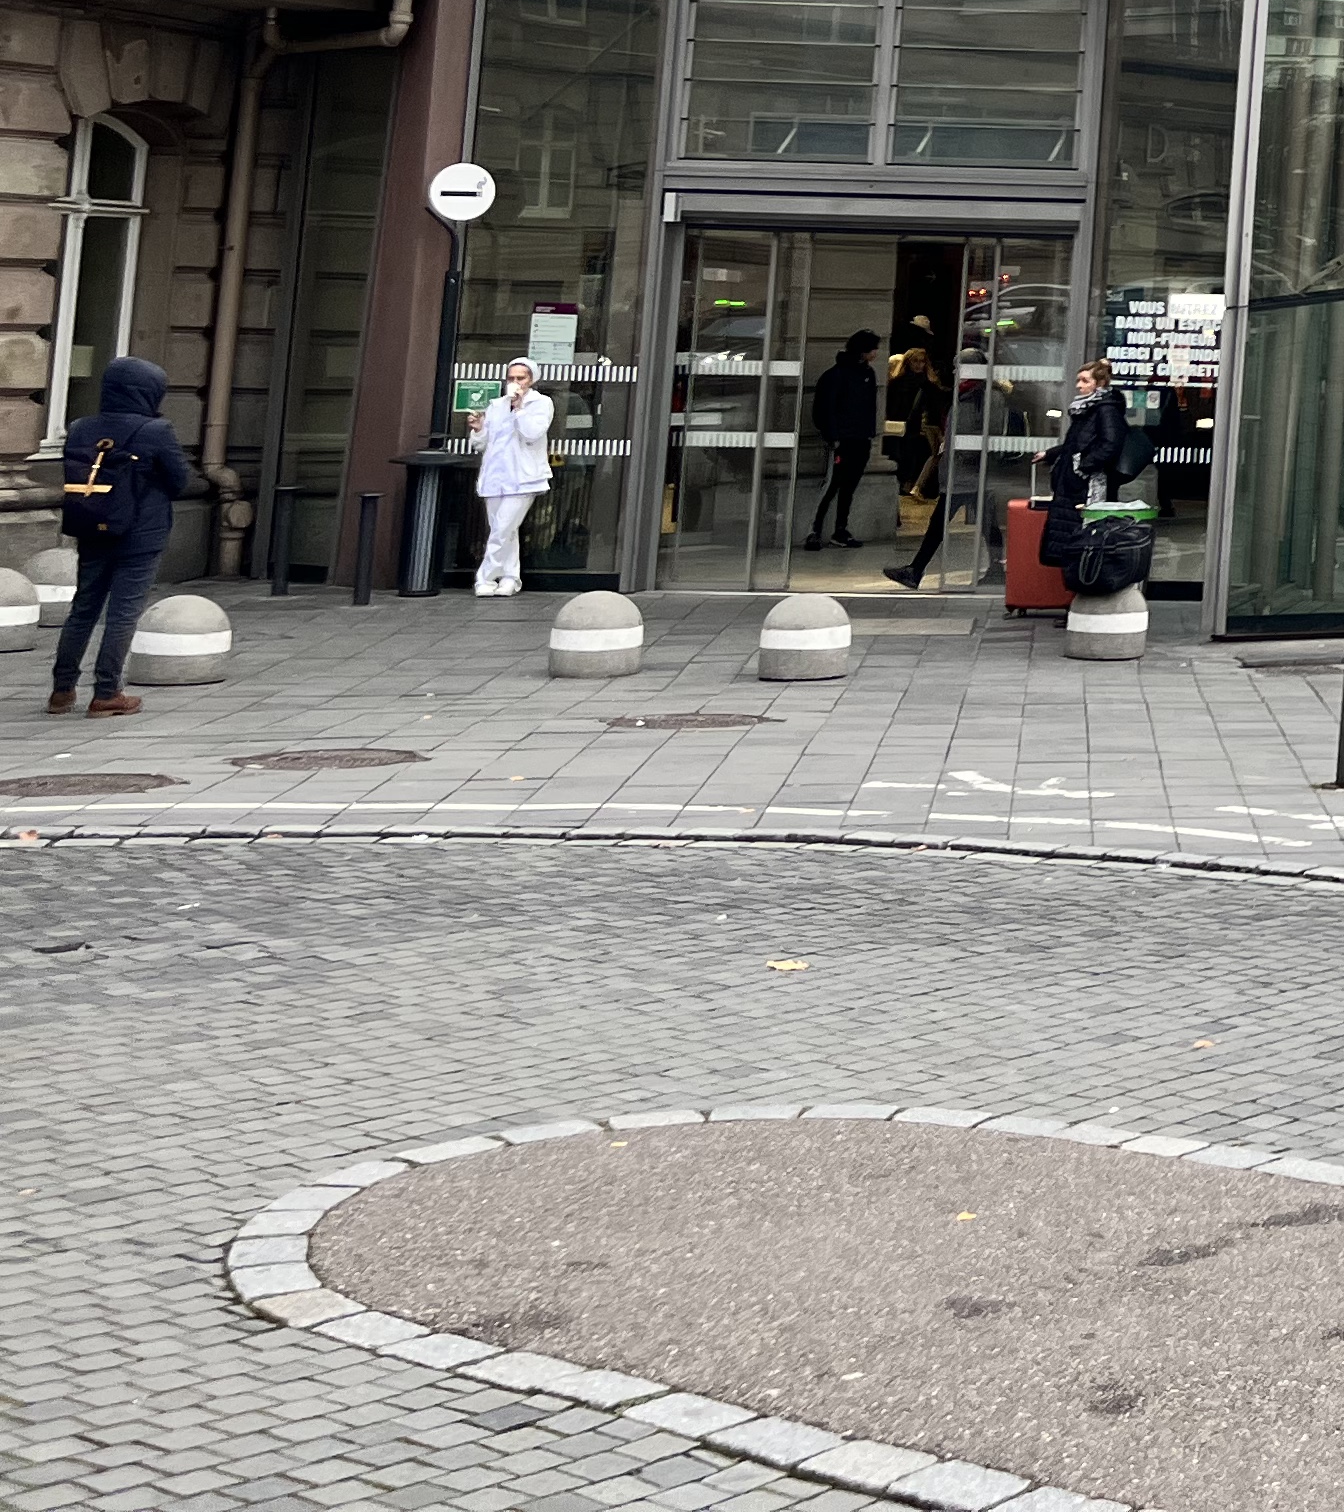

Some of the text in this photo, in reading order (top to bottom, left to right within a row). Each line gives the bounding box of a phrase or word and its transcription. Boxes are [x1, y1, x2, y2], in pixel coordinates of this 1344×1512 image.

[1128, 300, 1166, 316] VOUS
[1114, 315, 1221, 332] DANS UN ESPAC
[1106, 346, 1151, 361] MERCI
[1111, 361, 1155, 376] VOTRE
